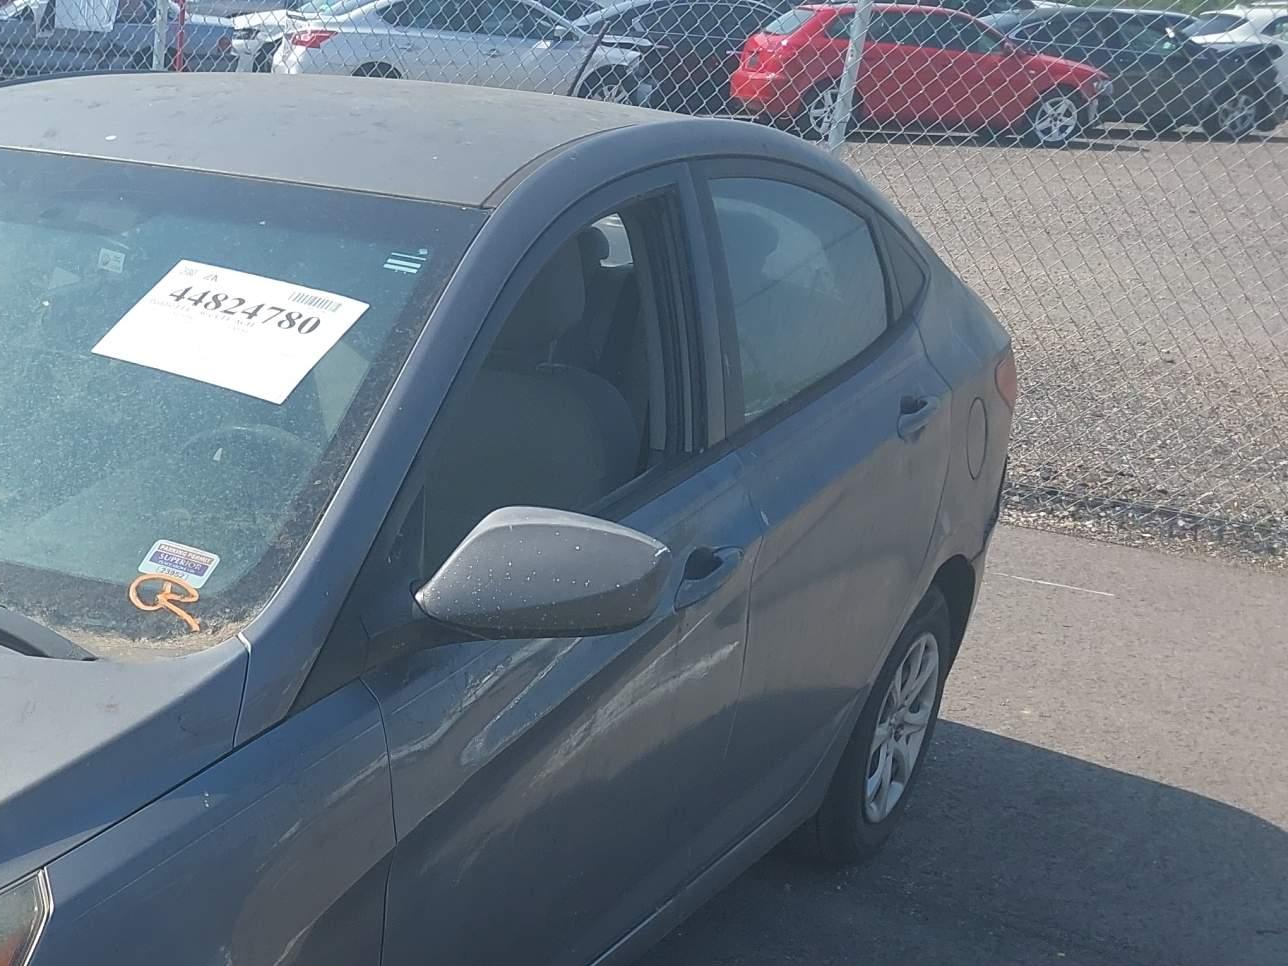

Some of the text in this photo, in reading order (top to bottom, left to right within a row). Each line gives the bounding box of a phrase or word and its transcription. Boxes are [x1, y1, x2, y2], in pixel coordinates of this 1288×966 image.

[169, 285, 321, 334] 44824780
[158, 553, 202, 570] SUPERIOR
[159, 544, 210, 564] PARKING PERMIT
